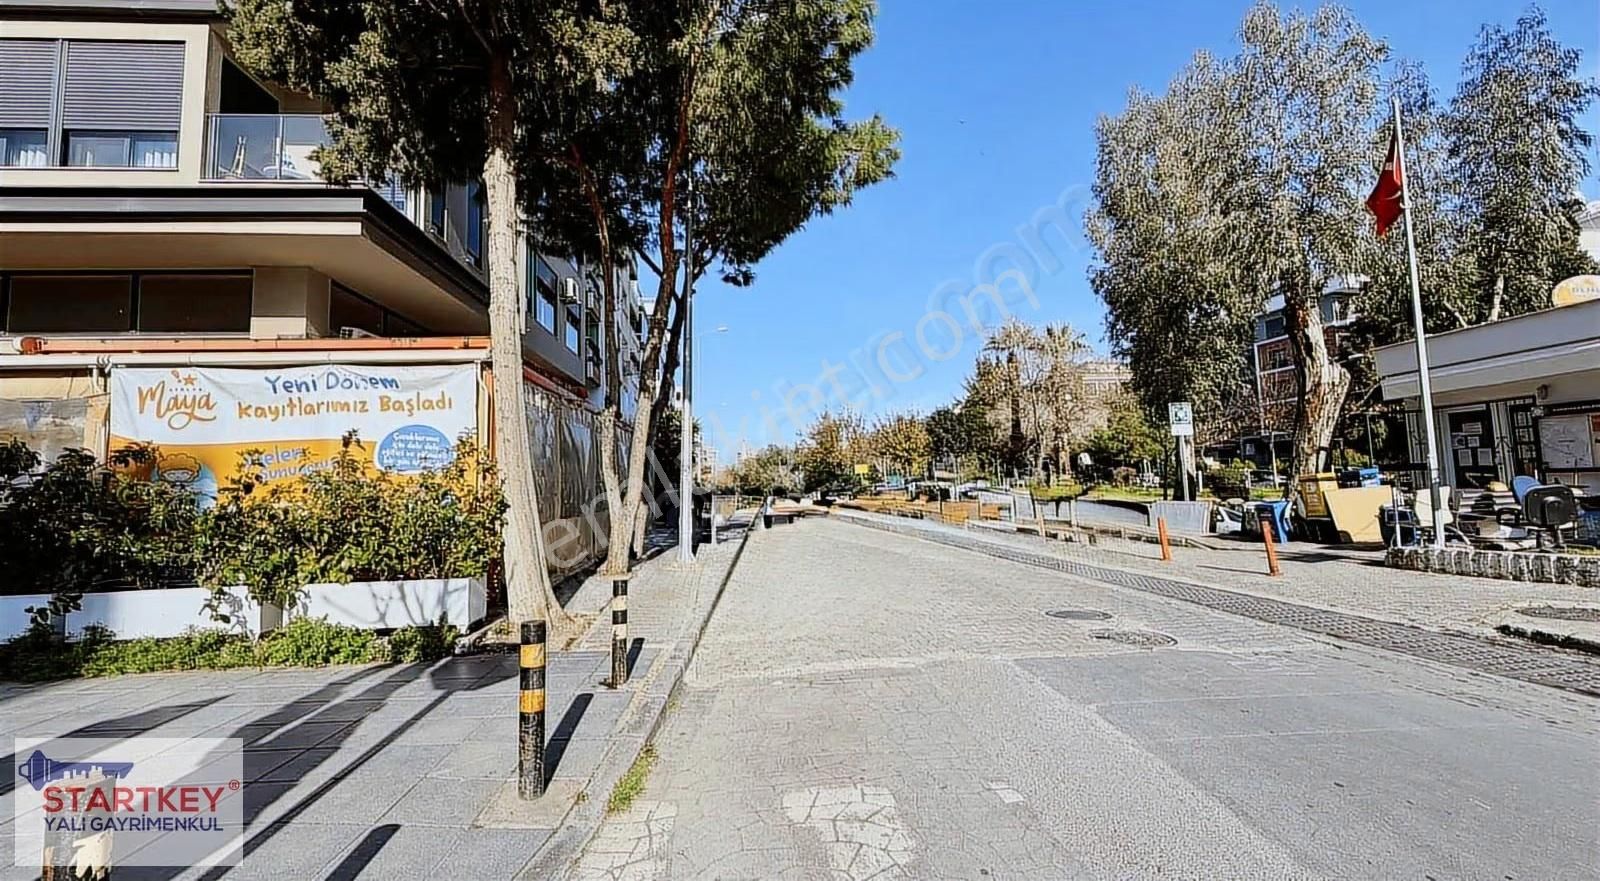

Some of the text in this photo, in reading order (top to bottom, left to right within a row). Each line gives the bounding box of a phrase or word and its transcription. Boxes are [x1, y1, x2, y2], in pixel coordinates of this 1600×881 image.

[264, 371, 399, 394] Yeni Dönem
[137, 380, 217, 430] Maya
[379, 390, 452, 417] Başladı
